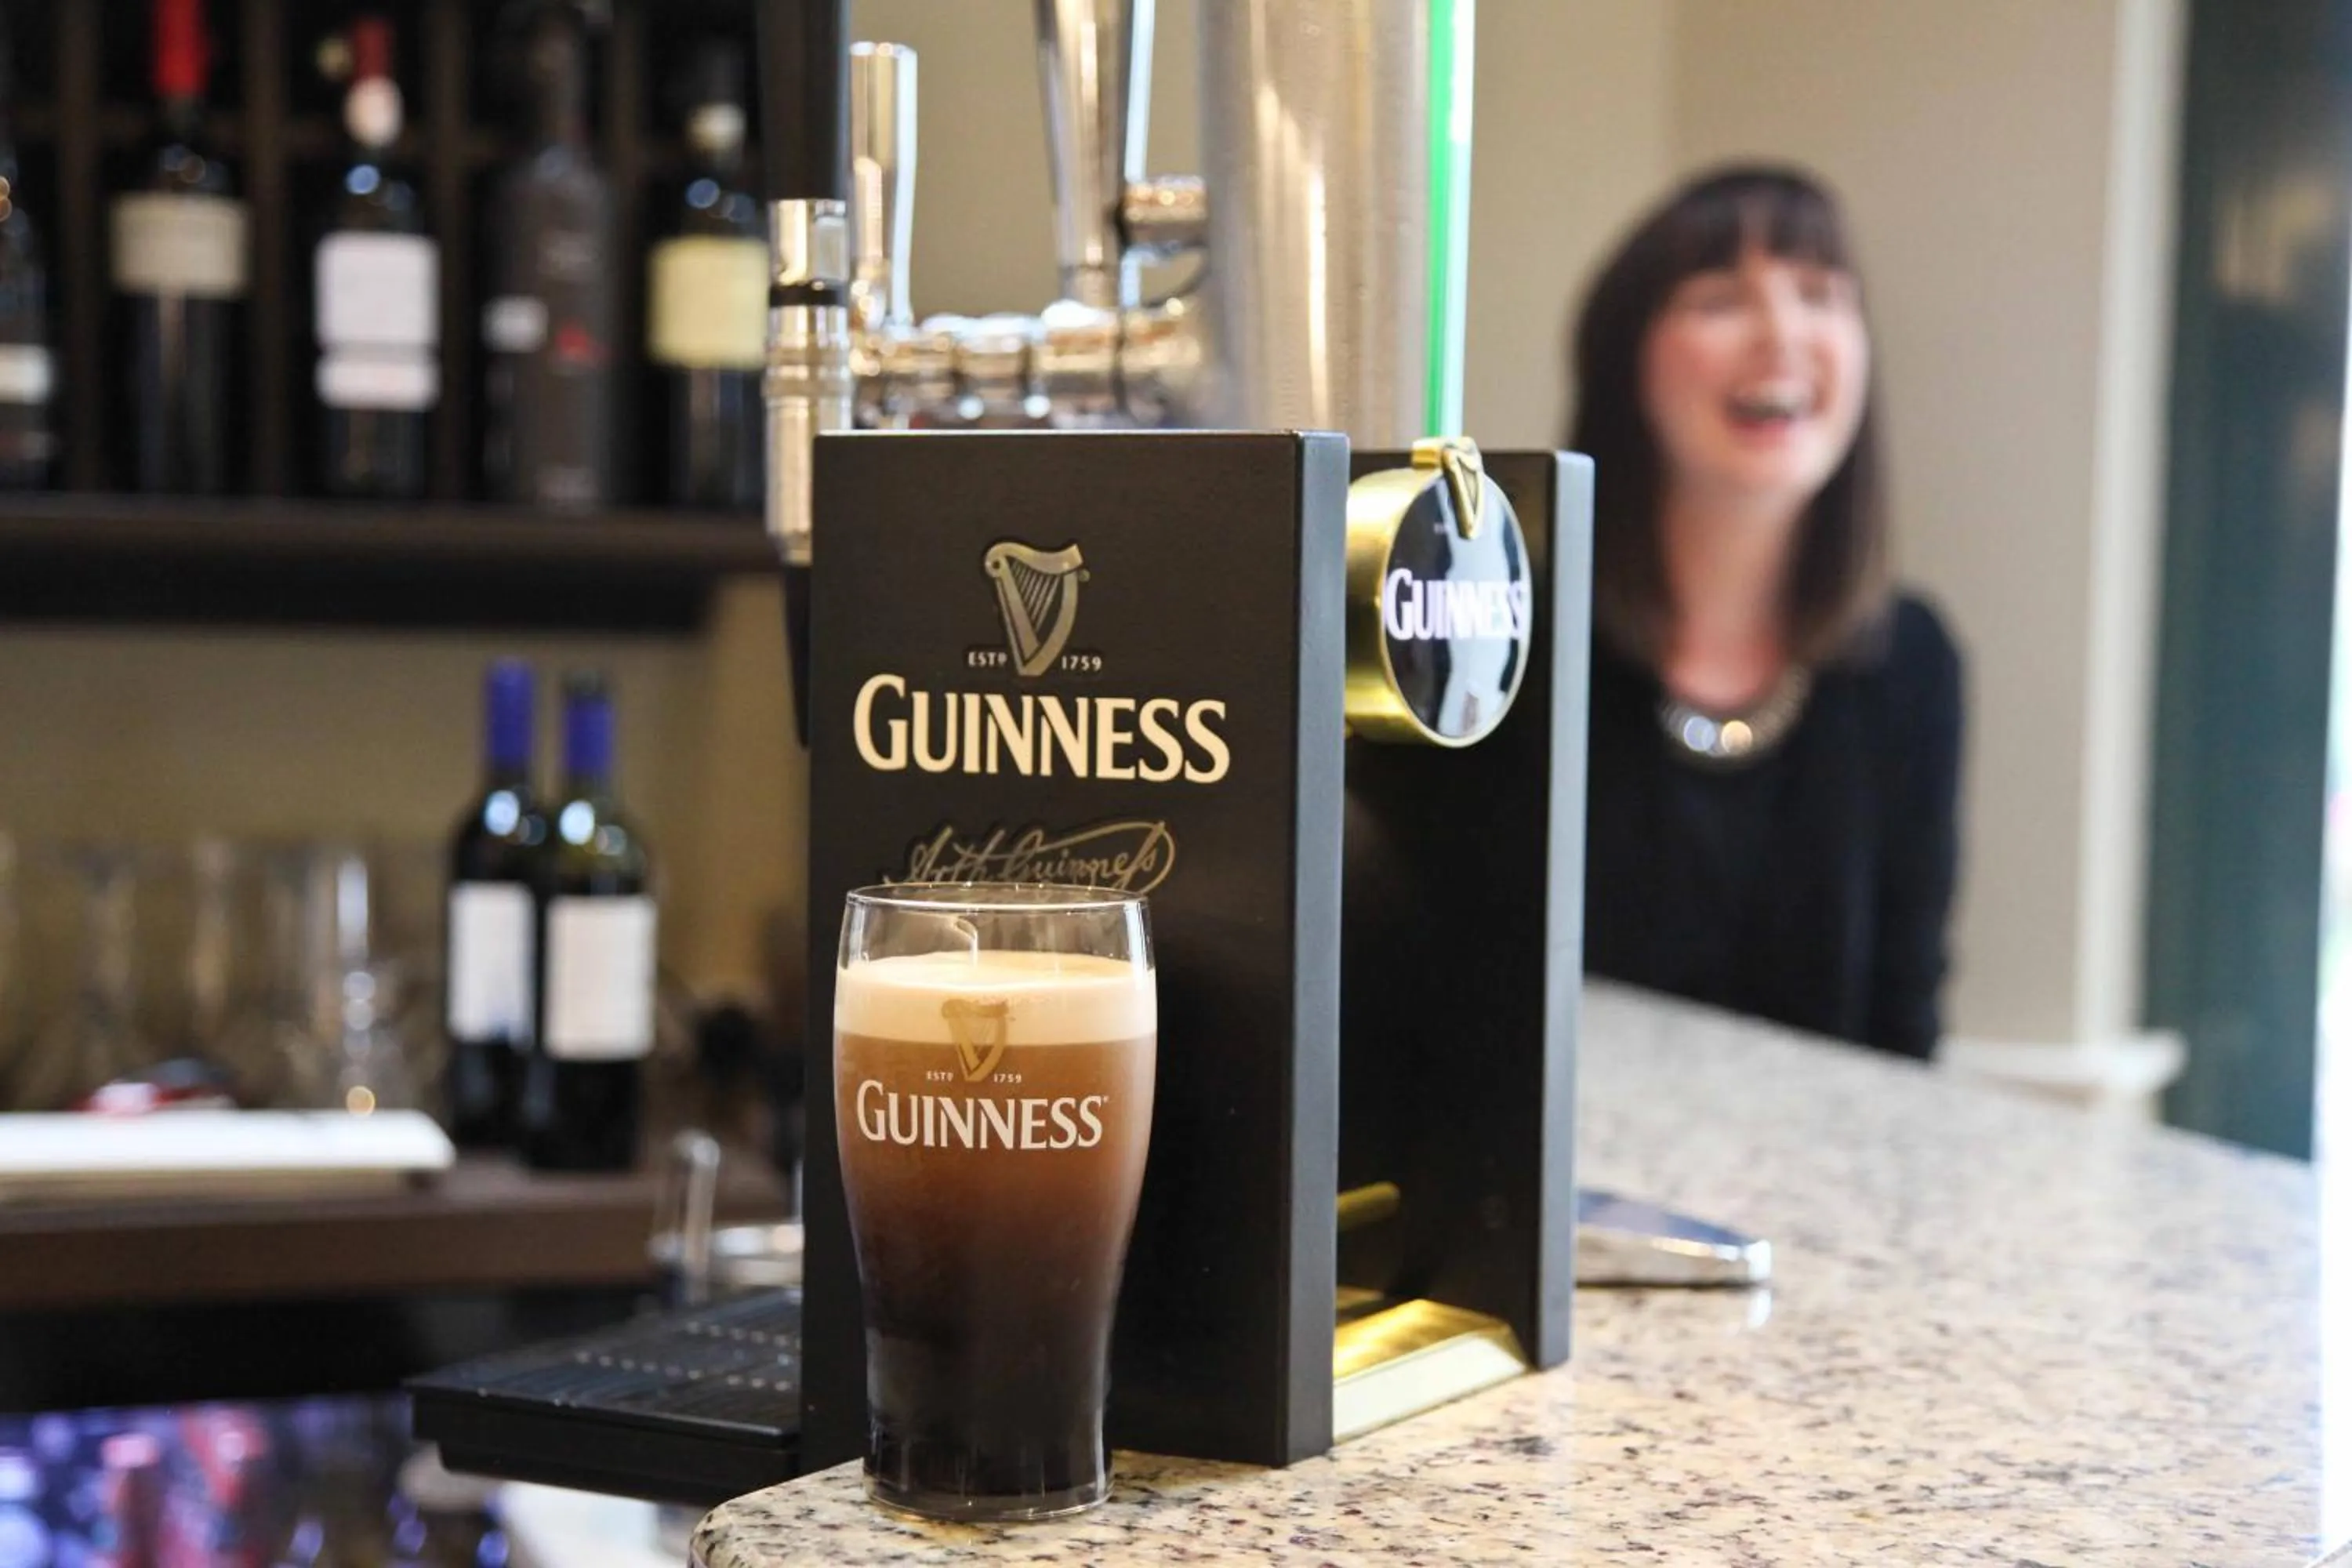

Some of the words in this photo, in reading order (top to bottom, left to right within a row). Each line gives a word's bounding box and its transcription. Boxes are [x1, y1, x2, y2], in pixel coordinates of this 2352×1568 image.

[1062, 655, 1102, 671] 1759
[853, 673, 1231, 784] GUINNESS
[993, 1073, 1022, 1083] 1759
[856, 1079, 1109, 1151] GUINNESS
